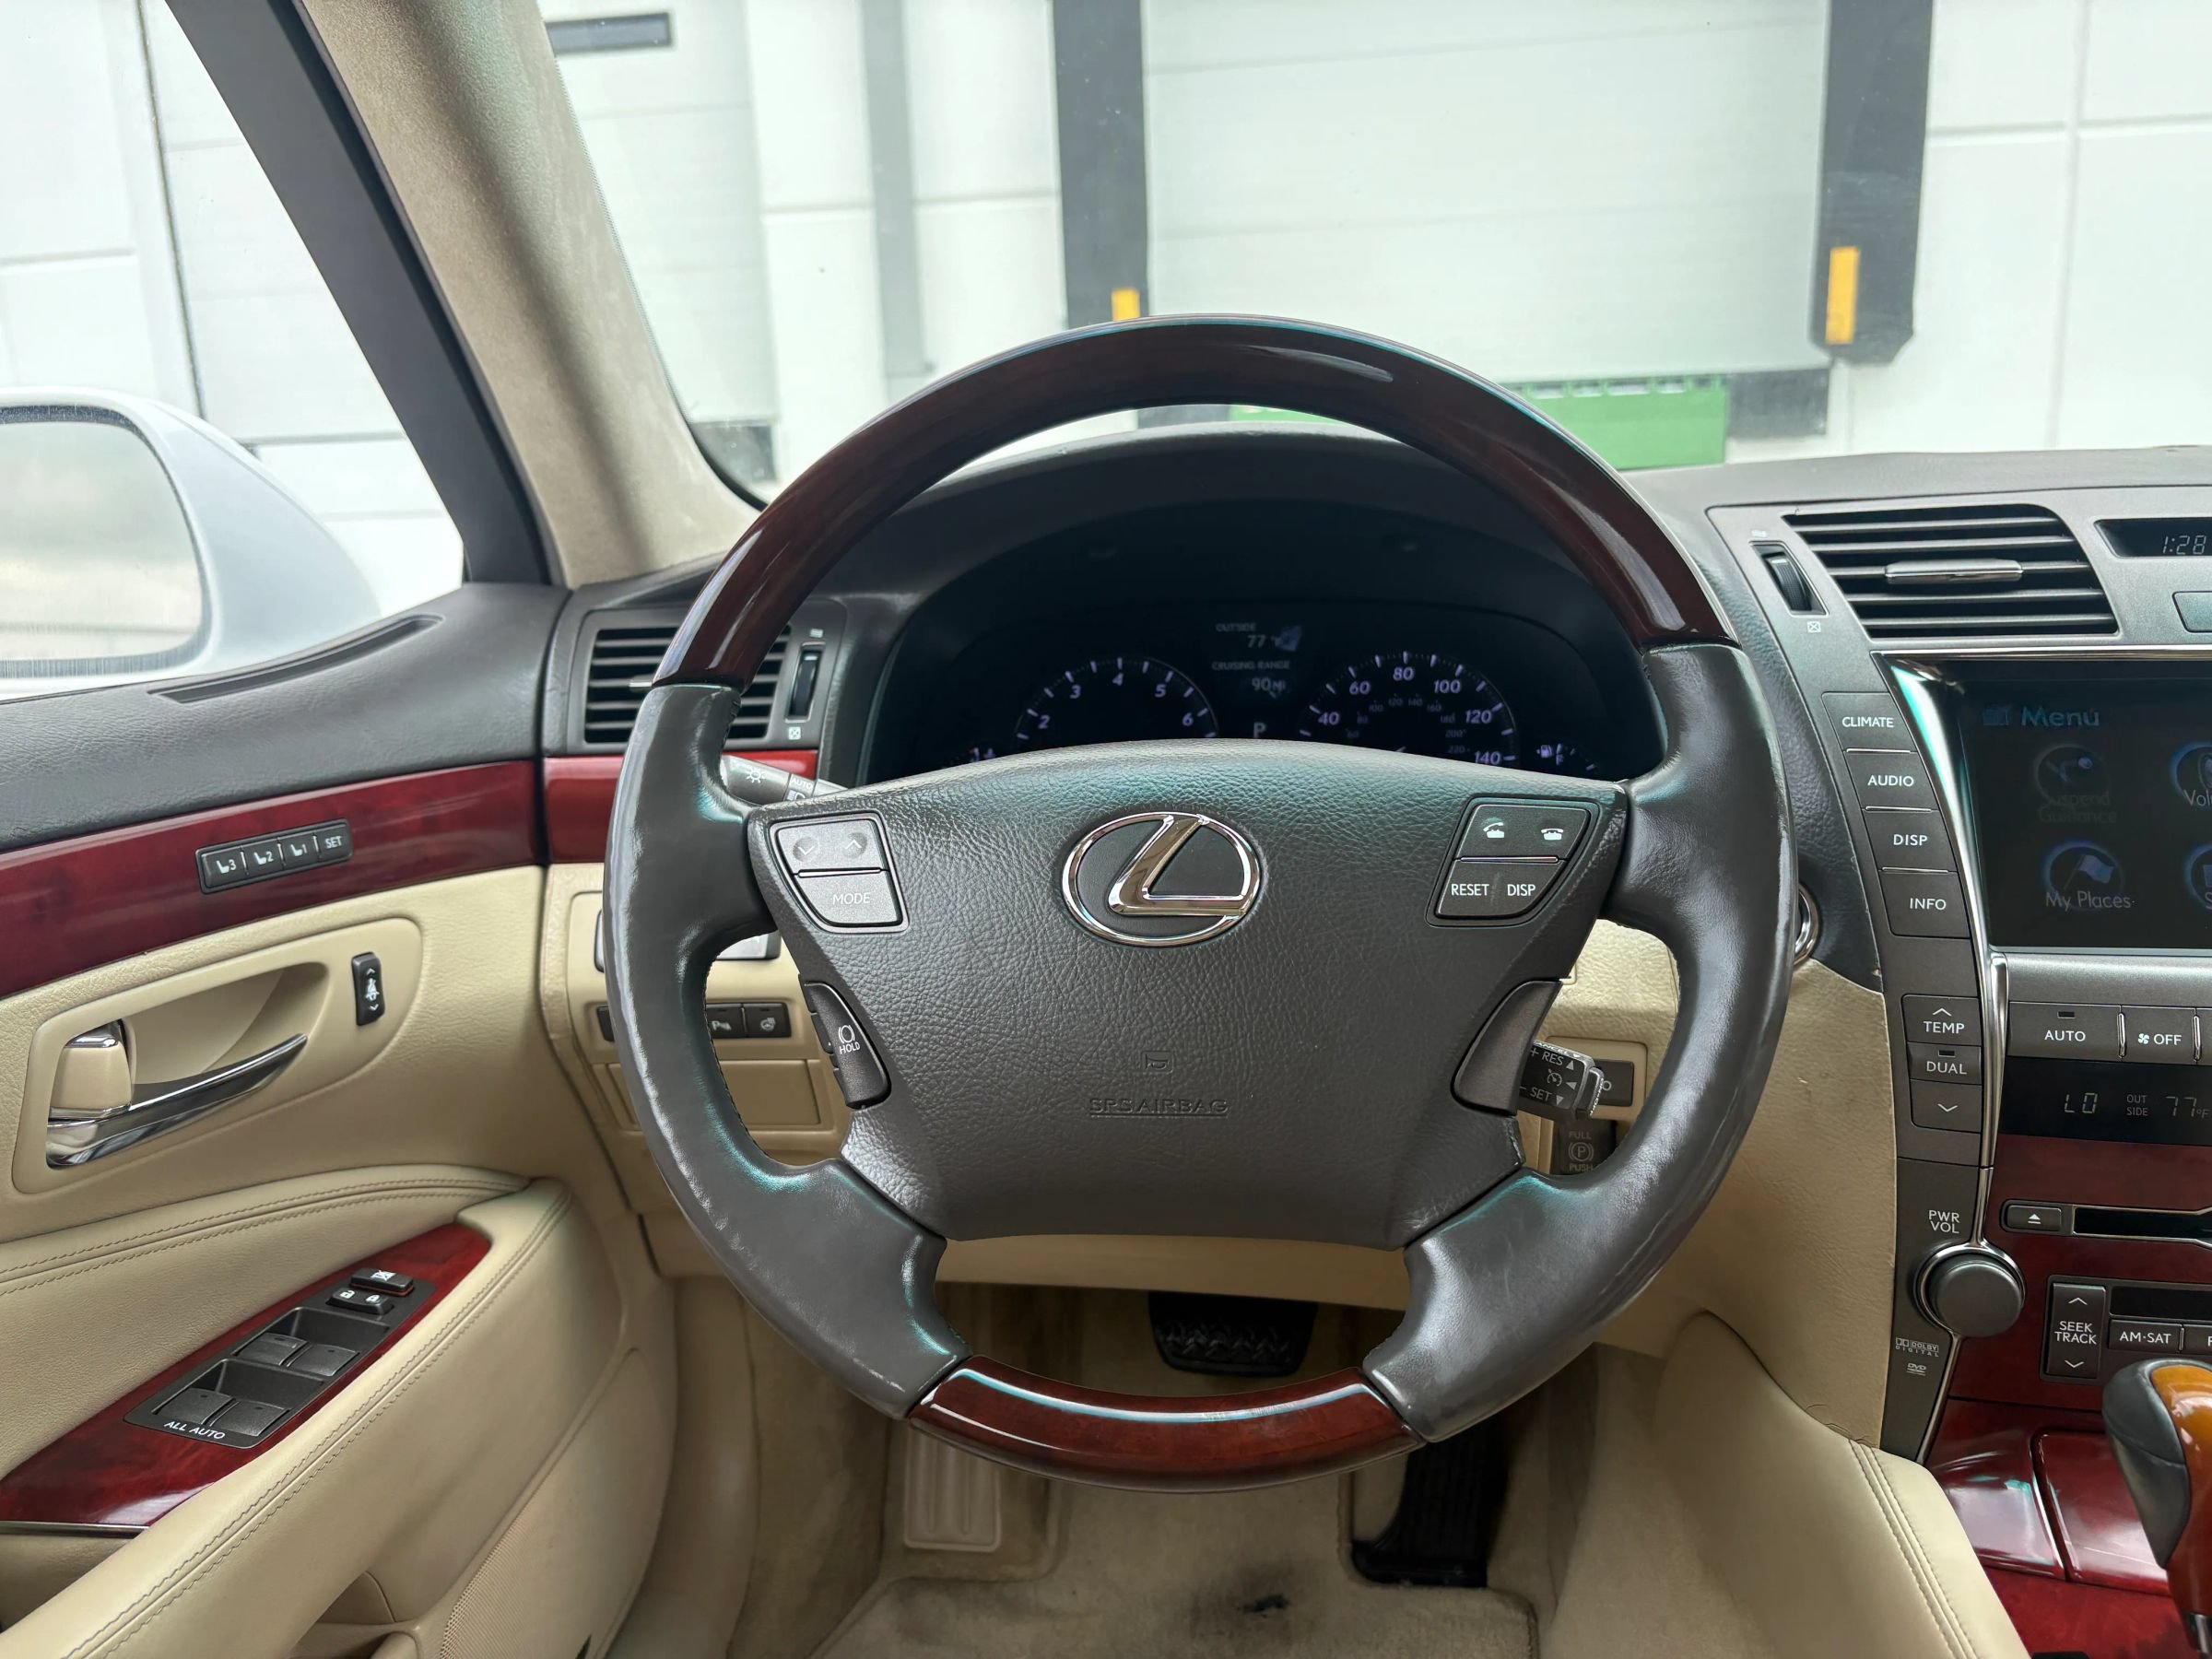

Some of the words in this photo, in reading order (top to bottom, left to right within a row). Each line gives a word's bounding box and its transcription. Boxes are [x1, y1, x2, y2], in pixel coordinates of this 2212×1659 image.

[2162, 535, 2206, 555] 1:28
[1247, 634, 1266, 648] 77
[1212, 661, 1255, 671] CRUISING
[1257, 660, 1290, 670] RANGE
[1112, 673, 1124, 686] 4
[1393, 667, 1415, 681] 80
[1155, 684, 1167, 698] 5
[1252, 677, 1271, 691] 90
[1349, 681, 1371, 694] 60
[1434, 679, 1461, 693] 100
[1069, 685, 1081, 699] 3
[1038, 714, 1051, 729] 2
[1182, 712, 1194, 726] 6
[1318, 712, 1340, 725] 40
[1465, 710, 1492, 724] 120
[1841, 715, 1894, 729] CLIMATE
[2021, 706, 2100, 726] Menu
[1253, 723, 1266, 737] P
[1475, 751, 1501, 764] 140
[791, 778, 812, 790] AUTO
[1867, 774, 1914, 788] AUDIO
[2183, 789, 2212, 807] Vol
[324, 836, 343, 849] SET
[1893, 833, 1929, 847] DISP
[301, 844, 308, 854] 1
[265, 851, 274, 862] 2
[228, 859, 237, 871] 3
[1451, 883, 1489, 896] RESET
[1507, 883, 1535, 897] DISP
[832, 892, 871, 905] MODE
[1909, 897, 1947, 912] INFO
[2045, 891, 2071, 912] My
[2077, 890, 2131, 910] Places
[1924, 1020, 1965, 1035] TEMP
[2044, 1030, 2086, 1042] AUTO
[2153, 1033, 2183, 1046] OFF
[839, 1041, 861, 1054] HOLD
[1542, 1051, 1564, 1066] RES
[1926, 1061, 1967, 1076] DUAL
[1530, 1088, 1552, 1101] SET
[2126, 1094, 2147, 1104] OUT
[2126, 1107, 2148, 1116] SIDE
[1569, 1130, 1592, 1140] PULL
[1570, 1163, 1594, 1171] PUSH
[1928, 1209, 1960, 1223] PWR
[1930, 1220, 1959, 1234] VOL
[2060, 1320, 2092, 1333] SEEK
[2054, 1331, 2097, 1345] TRACK
[1895, 1346, 1939, 1358] DIGITAL
[1911, 1341, 1939, 1351] DOLBY
[1907, 1362, 1927, 1372] DVD
[163, 1420, 186, 1431] ALL
[189, 1426, 226, 1440] AUTO
